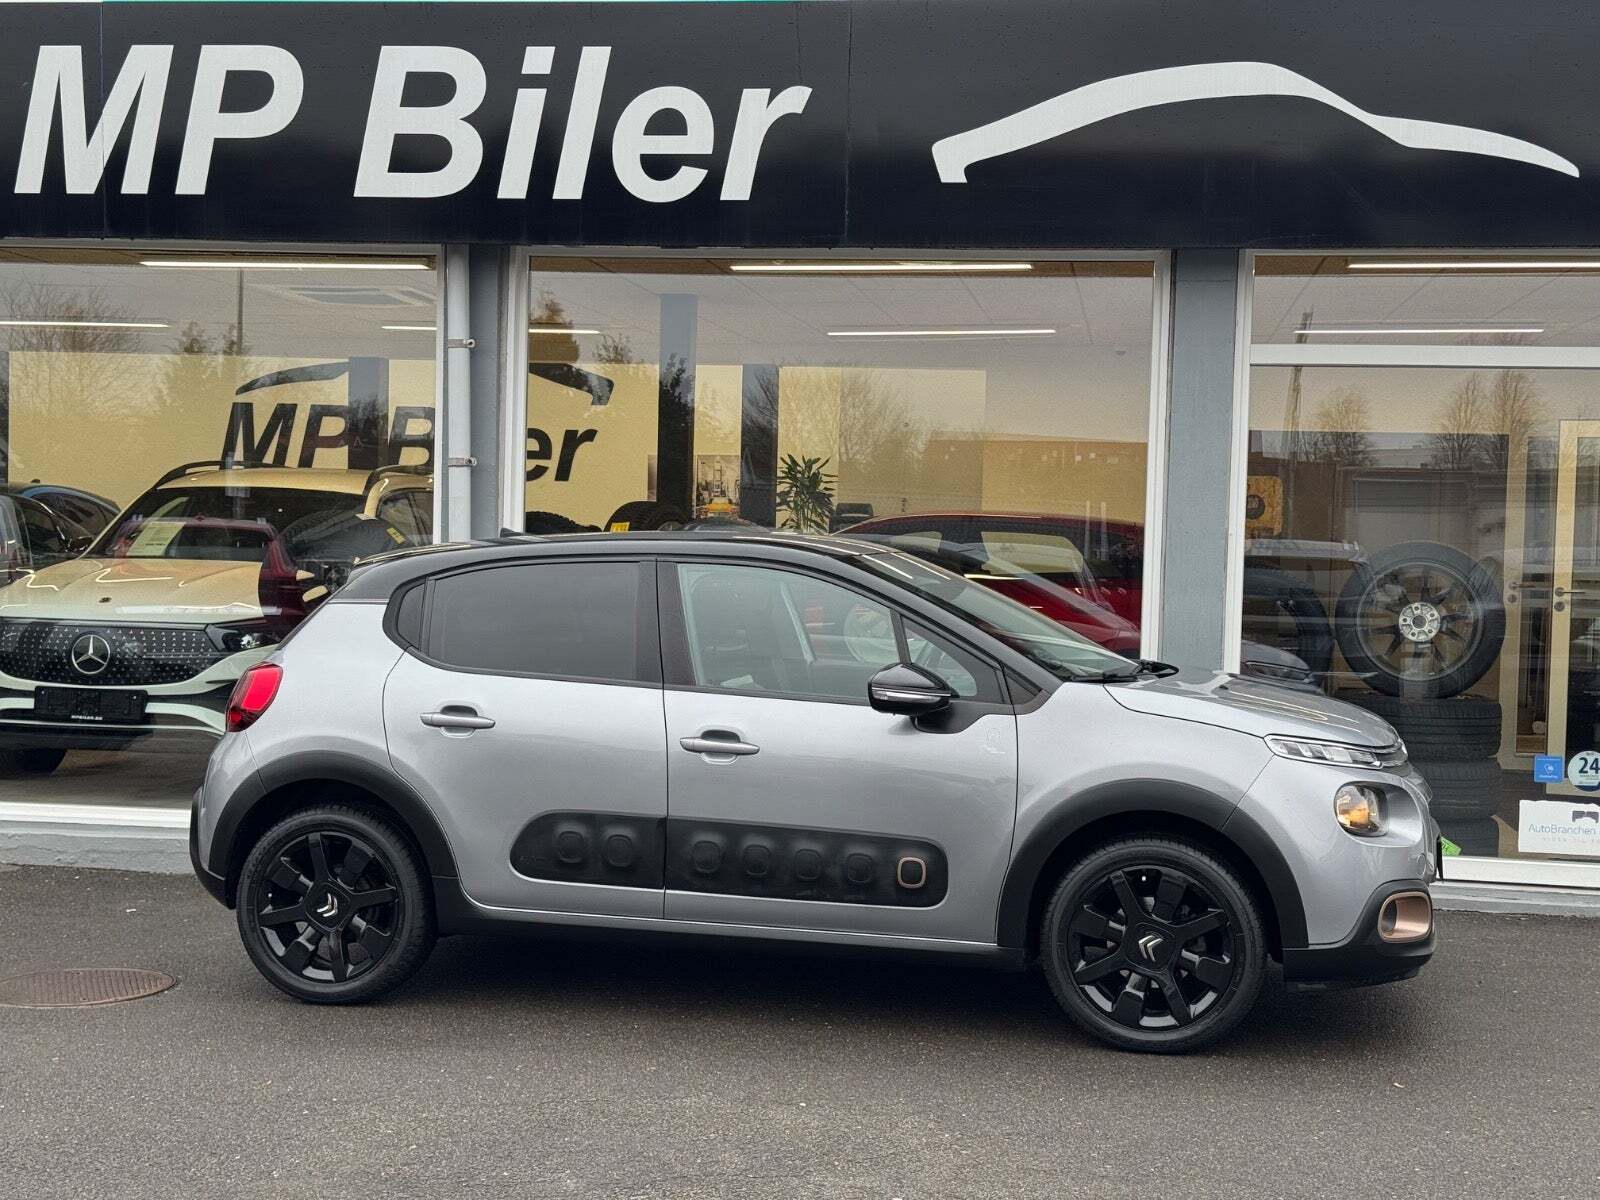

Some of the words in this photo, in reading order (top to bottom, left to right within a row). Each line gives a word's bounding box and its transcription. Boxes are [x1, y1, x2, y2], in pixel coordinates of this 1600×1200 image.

[15, 45, 303, 195] MP
[354, 46, 812, 203] Biler
[220, 402, 349, 469] MP
[1578, 757, 1600, 774] 24
[1528, 823, 1596, 836] AutoBranchen
